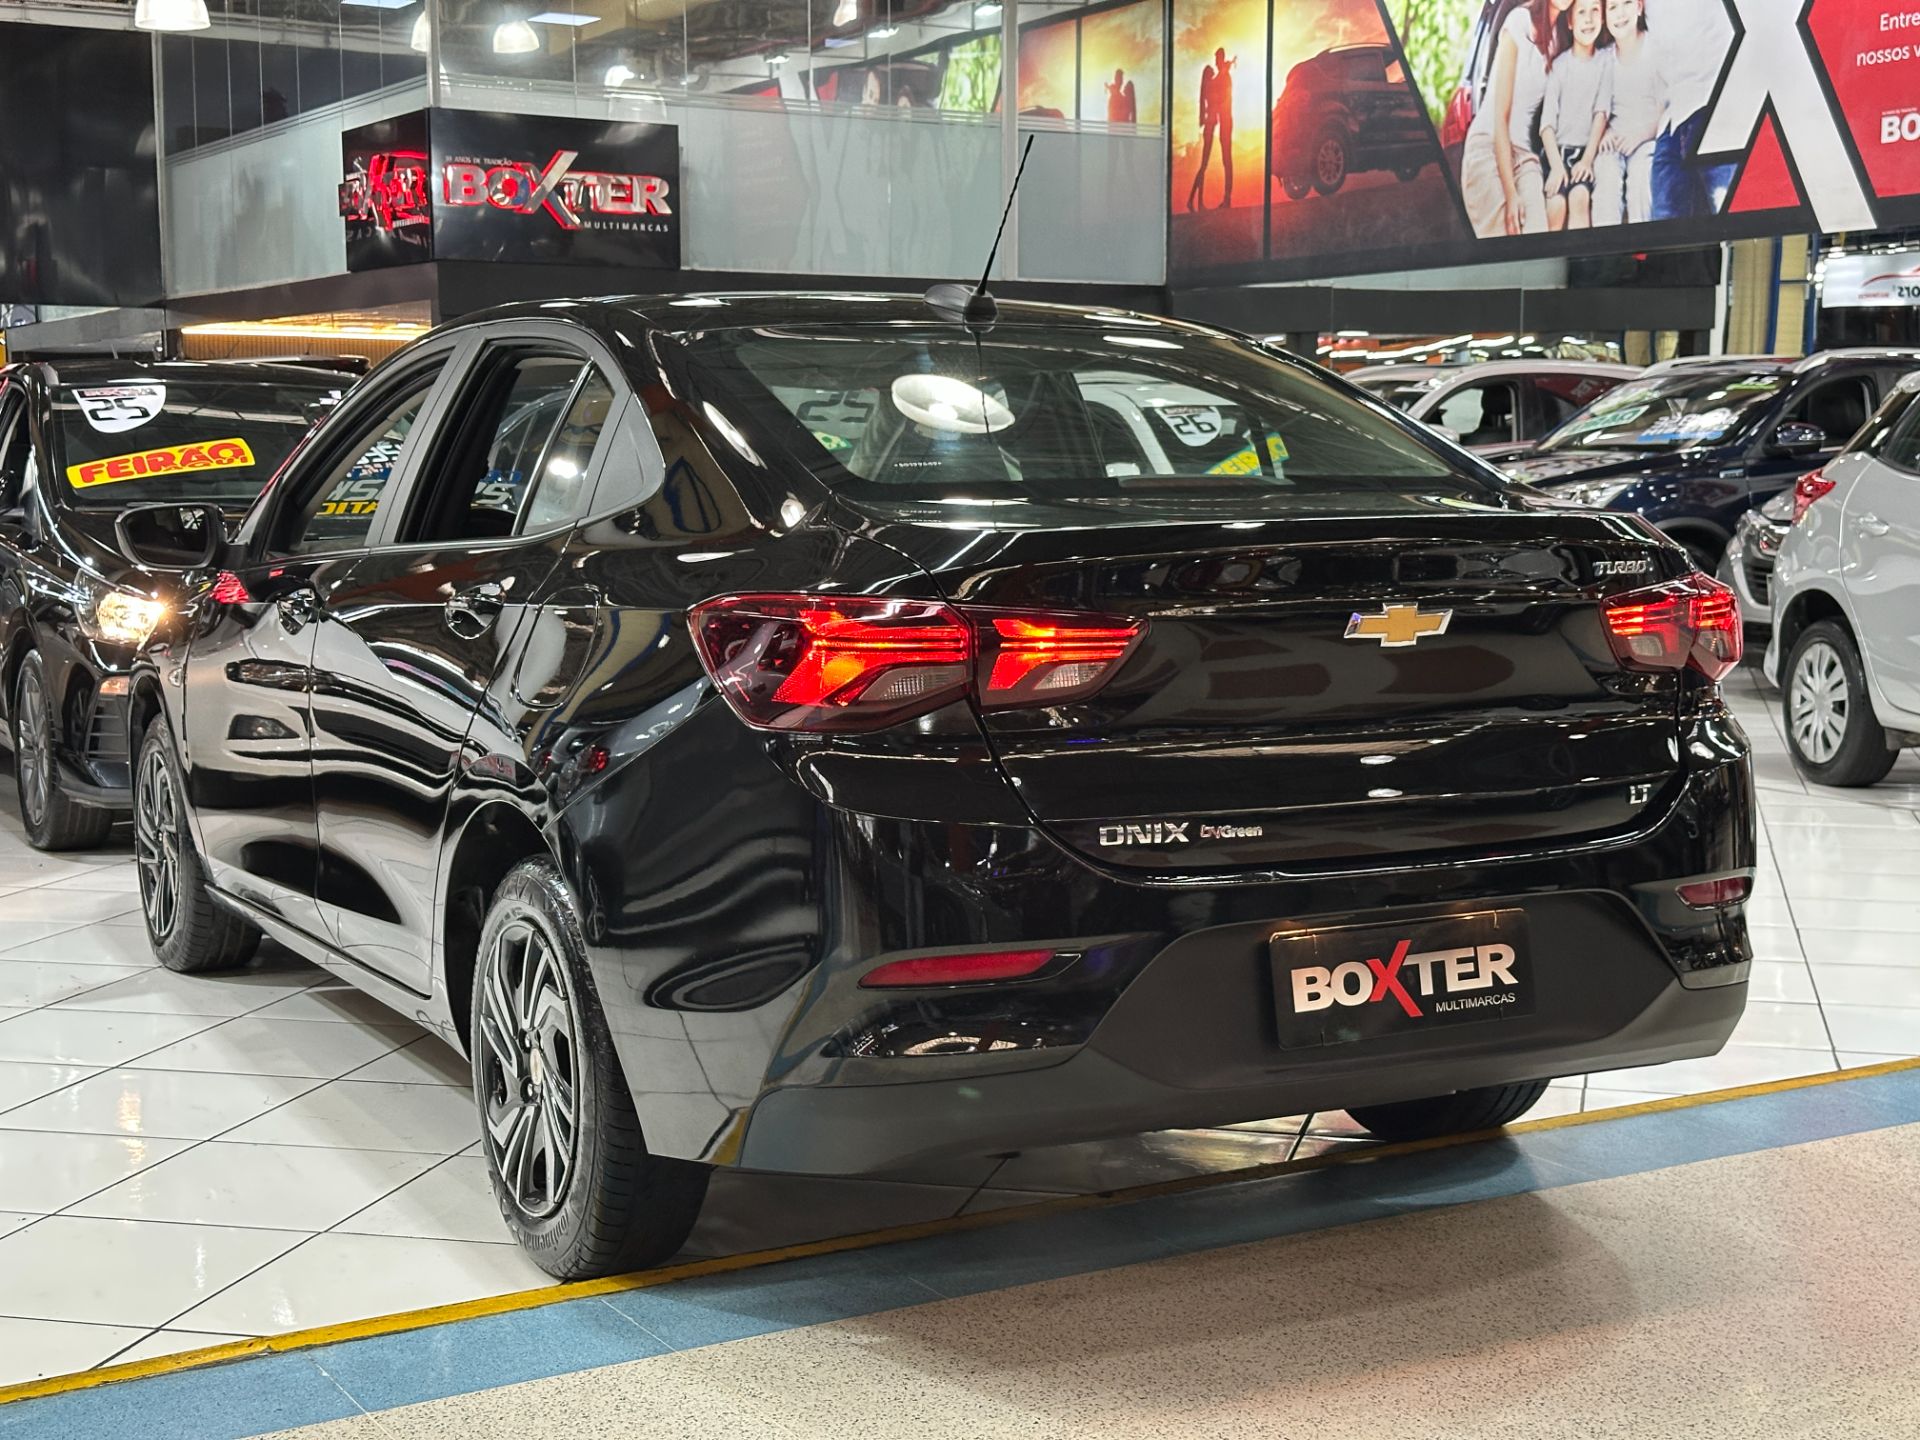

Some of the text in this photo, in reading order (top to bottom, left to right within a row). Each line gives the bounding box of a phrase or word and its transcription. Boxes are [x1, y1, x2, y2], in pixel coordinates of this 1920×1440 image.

[1856, 45, 1910, 67] nossos
[442, 149, 672, 229] BOXTER
[584, 220, 669, 233] MULTIMARCAS
[85, 397, 151, 422] 25
[1168, 414, 1217, 436] 26
[79, 442, 246, 484] FEIRÃO
[1592, 560, 1647, 577] TURBO
[1629, 783, 1652, 805] LT
[1099, 822, 1190, 847] ONIX
[1291, 939, 1519, 1018] BOXTER
[1435, 992, 1516, 1014] MULTIMARCAS
